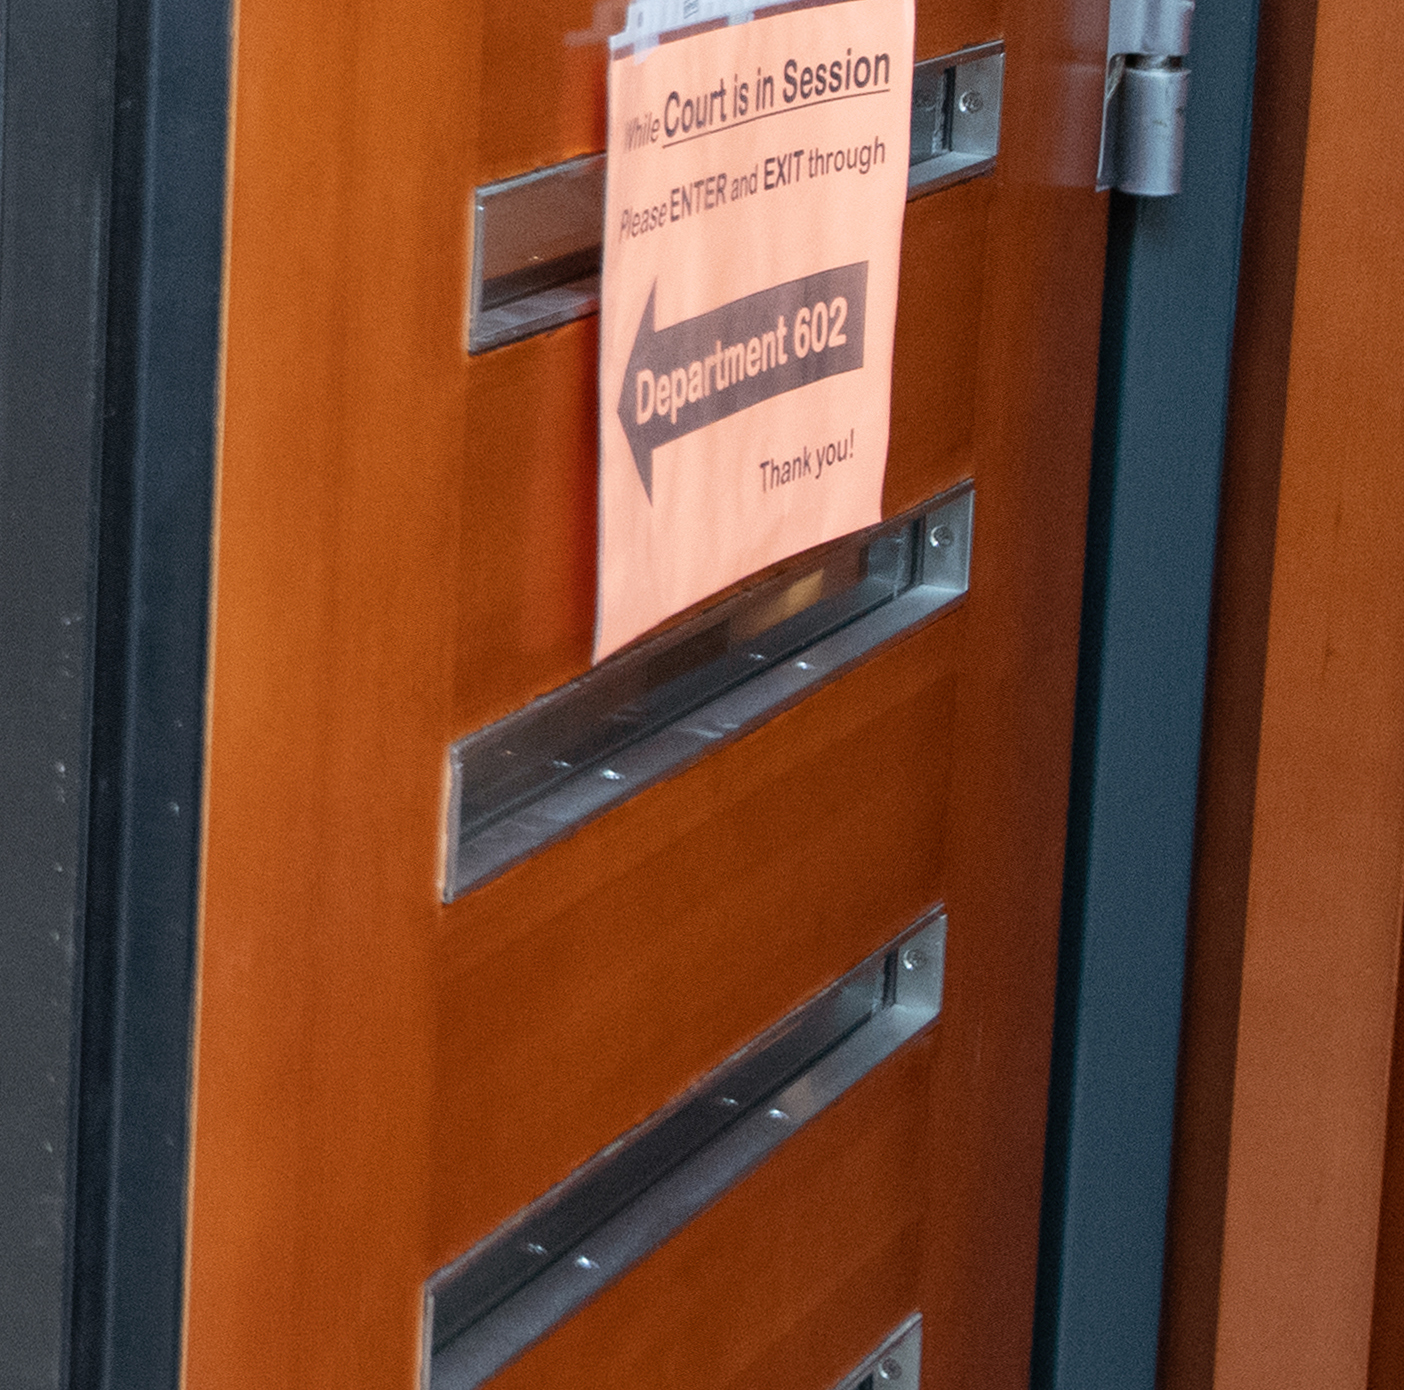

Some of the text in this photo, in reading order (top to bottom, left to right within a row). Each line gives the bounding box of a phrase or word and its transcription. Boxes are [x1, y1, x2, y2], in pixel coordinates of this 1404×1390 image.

[664, 78, 727, 138] Court
[732, 72, 750, 118] is
[755, 66, 775, 112] in
[781, 47, 891, 104] Session
[618, 135, 885, 244] Please ENTER and EXIT through
[635, 295, 849, 426] Department 602
[759, 427, 856, 494] Thank you!
